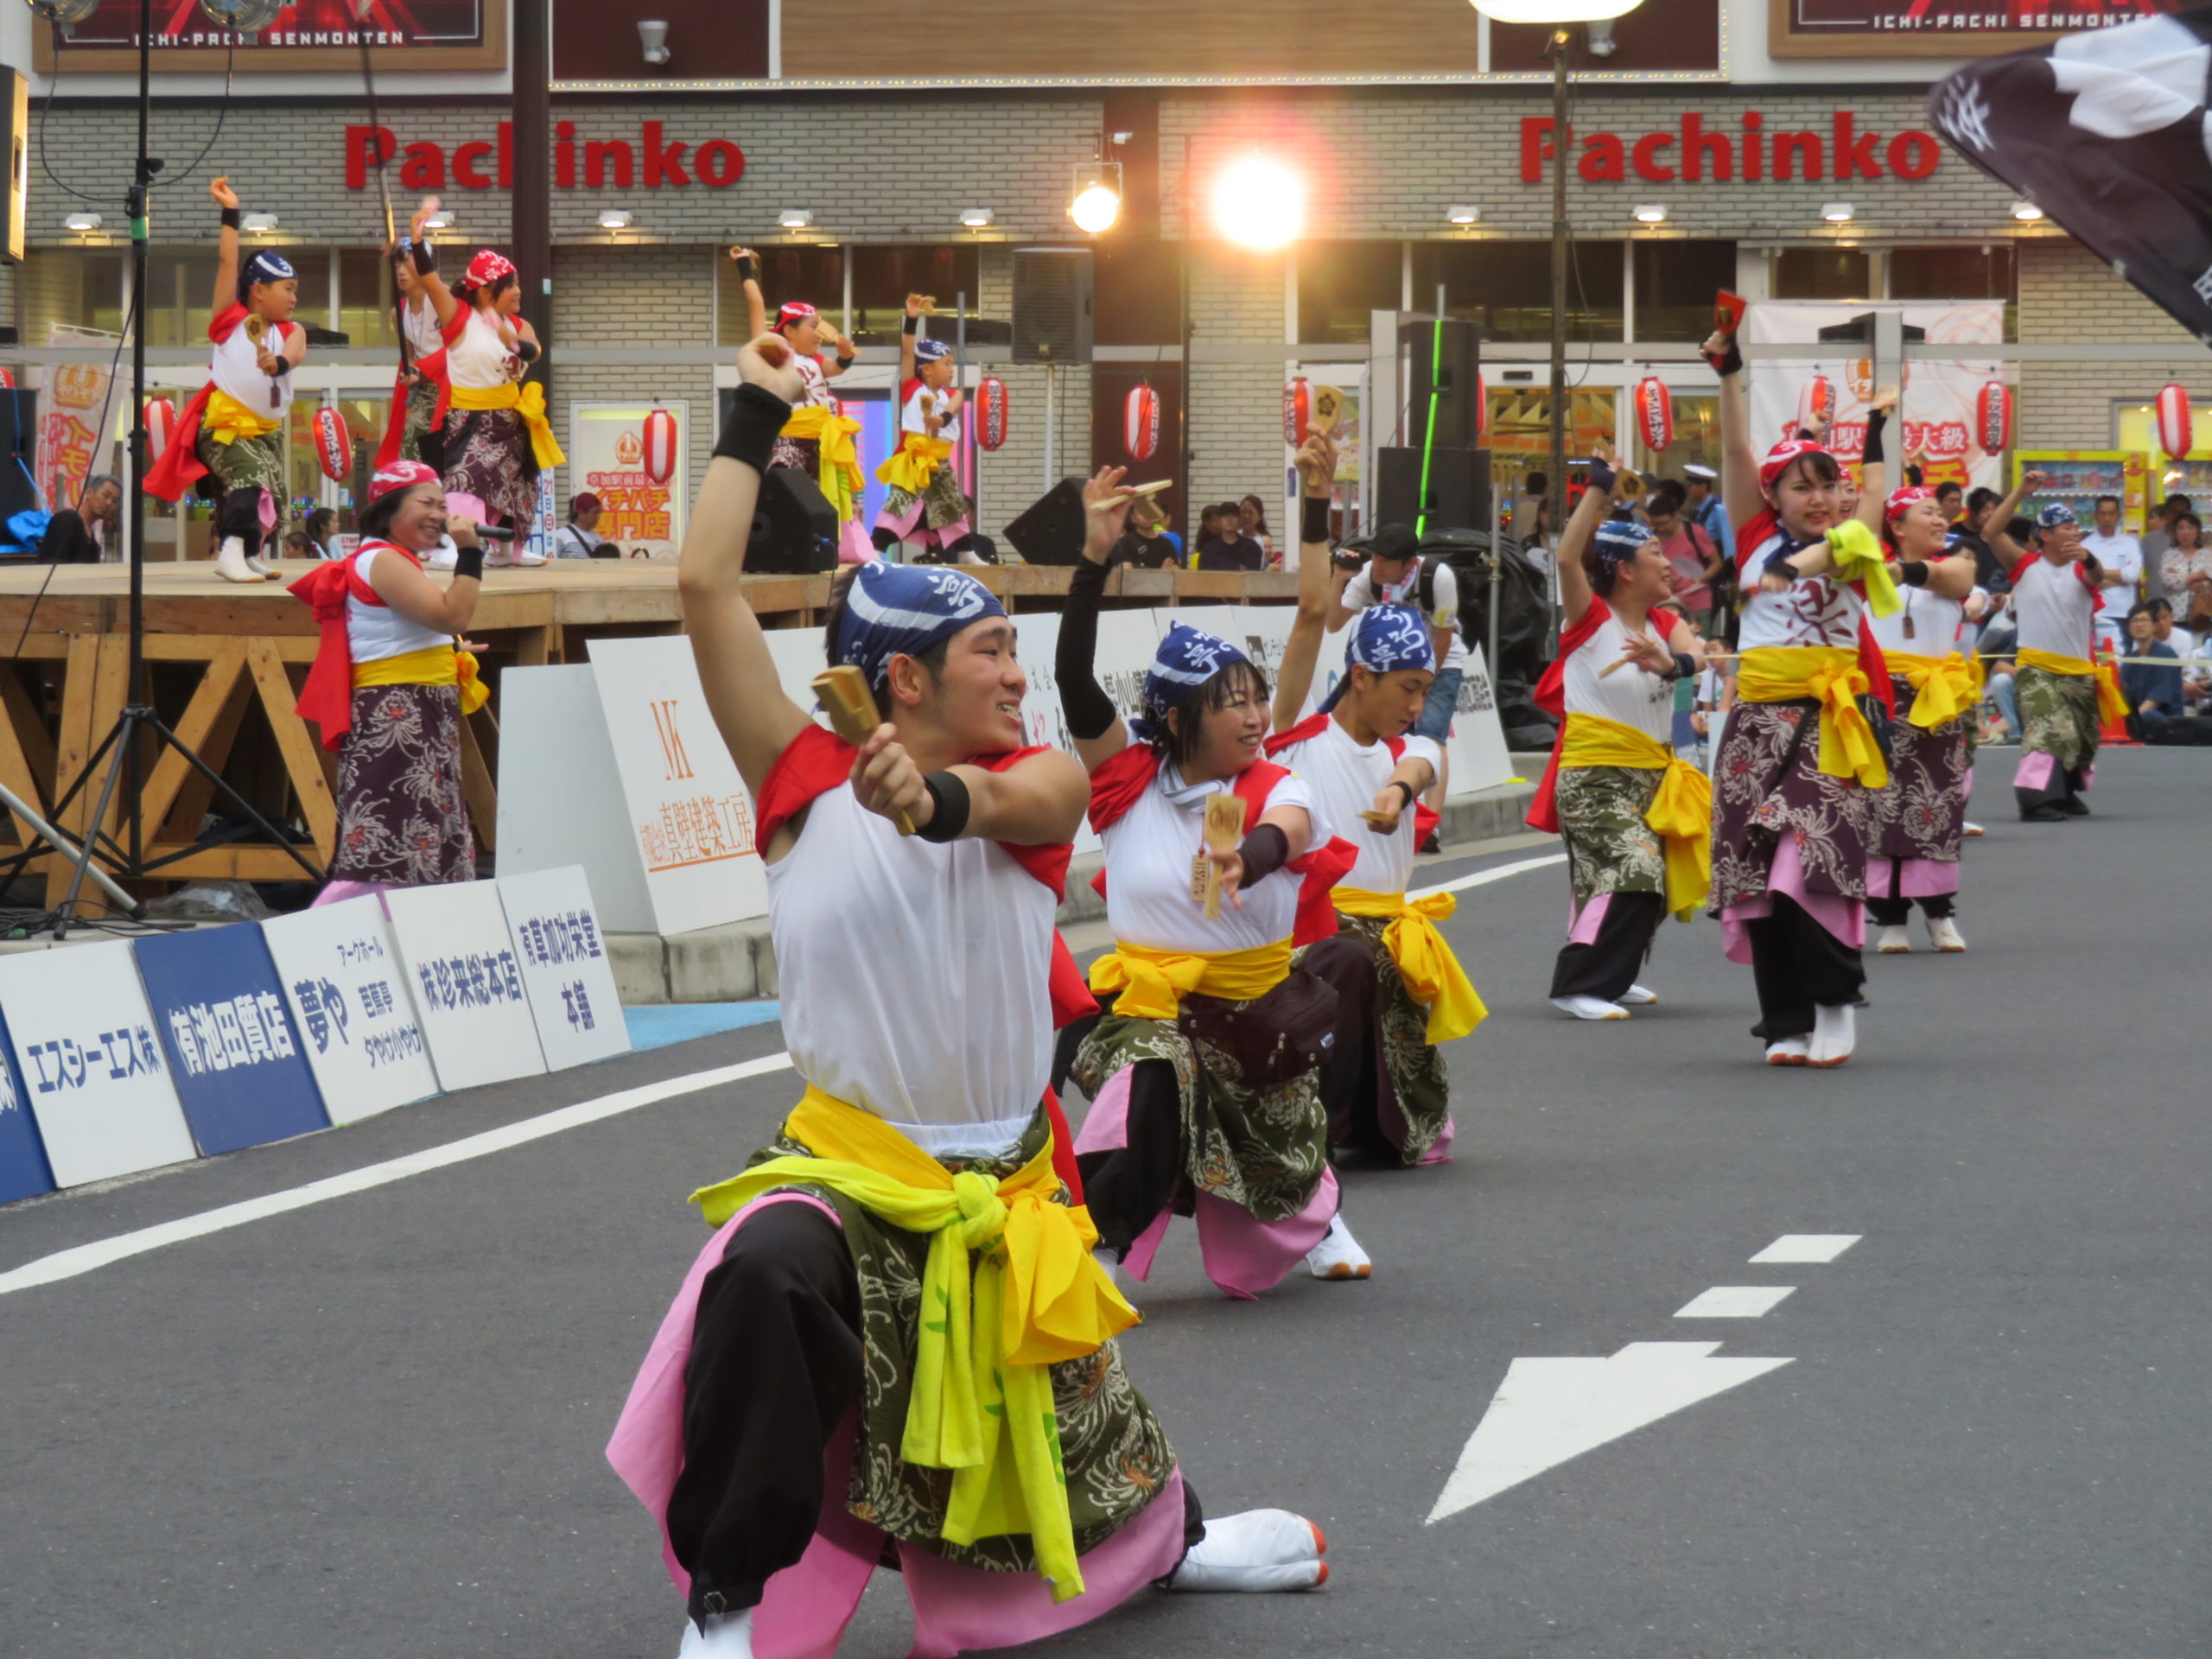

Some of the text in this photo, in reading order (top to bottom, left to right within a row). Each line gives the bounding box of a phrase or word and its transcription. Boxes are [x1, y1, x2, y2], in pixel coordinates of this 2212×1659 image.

[270, 31, 404, 44] SENMONTEN
[1873, 13, 2162, 29] ICHI-PACHI SENMONTE
[1520, 110, 1942, 182] Pachinko
[588, 473, 670, 486] 草加駅前最
[336, 935, 385, 968] アークホール
[293, 976, 350, 1055] 夢や
[365, 1022, 423, 1069] 夕やけ小やけ
